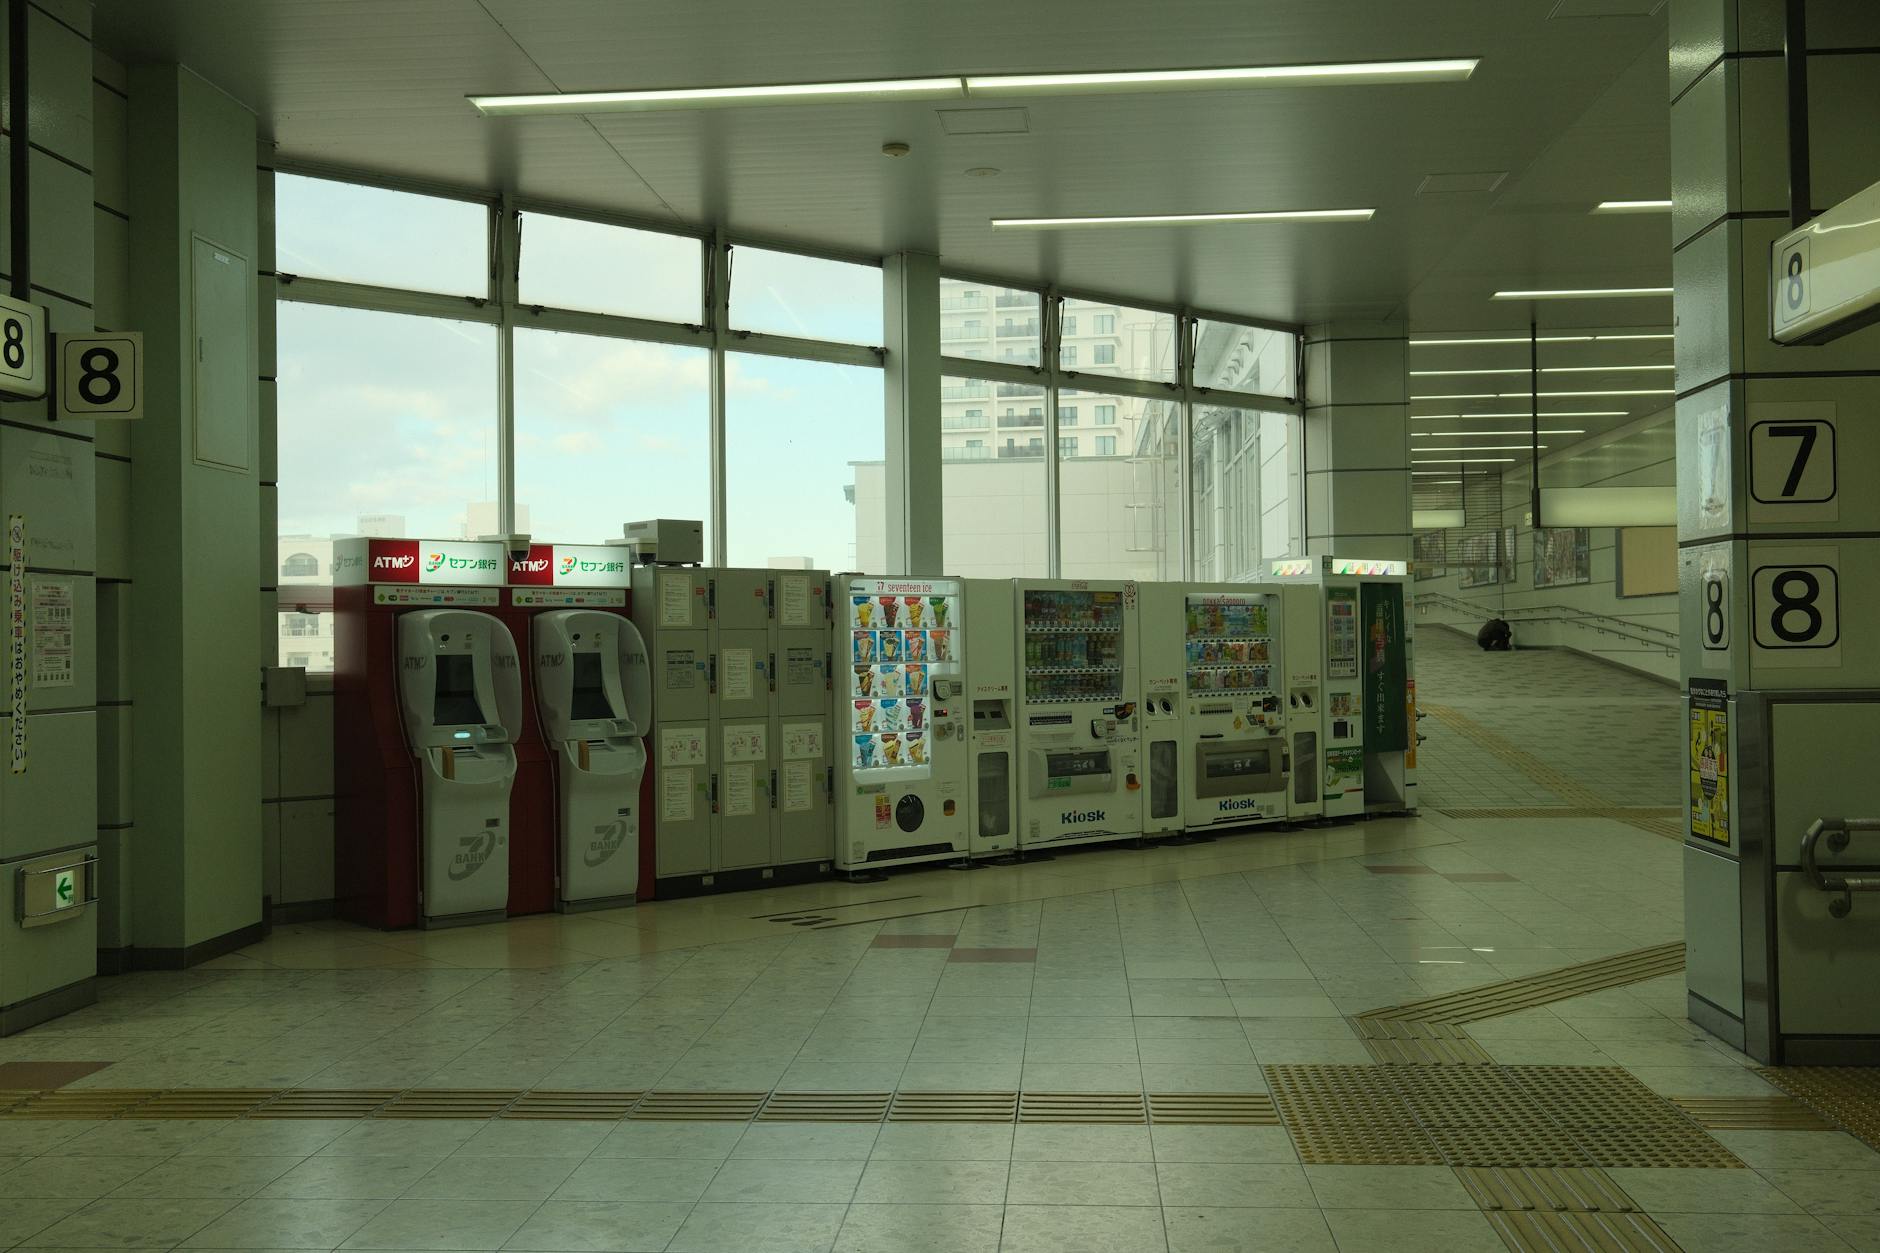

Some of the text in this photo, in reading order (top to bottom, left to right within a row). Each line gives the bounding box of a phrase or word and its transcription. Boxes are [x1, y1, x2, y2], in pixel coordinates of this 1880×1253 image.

[1788, 252, 1804, 310] 8
[3, 318, 24, 369] 8
[78, 347, 121, 404] 8
[1768, 426, 1817, 496] 7
[449, 557, 497, 570] セブン銀行
[580, 560, 624, 572] セブン銀行
[1707, 580, 1724, 643] 8
[1771, 570, 1822, 642] 8
[13, 549, 24, 761] 駆け込み乗車はおやめください
[1061, 810, 1106, 824] Kiosk
[1219, 799, 1256, 811] Kiosk
